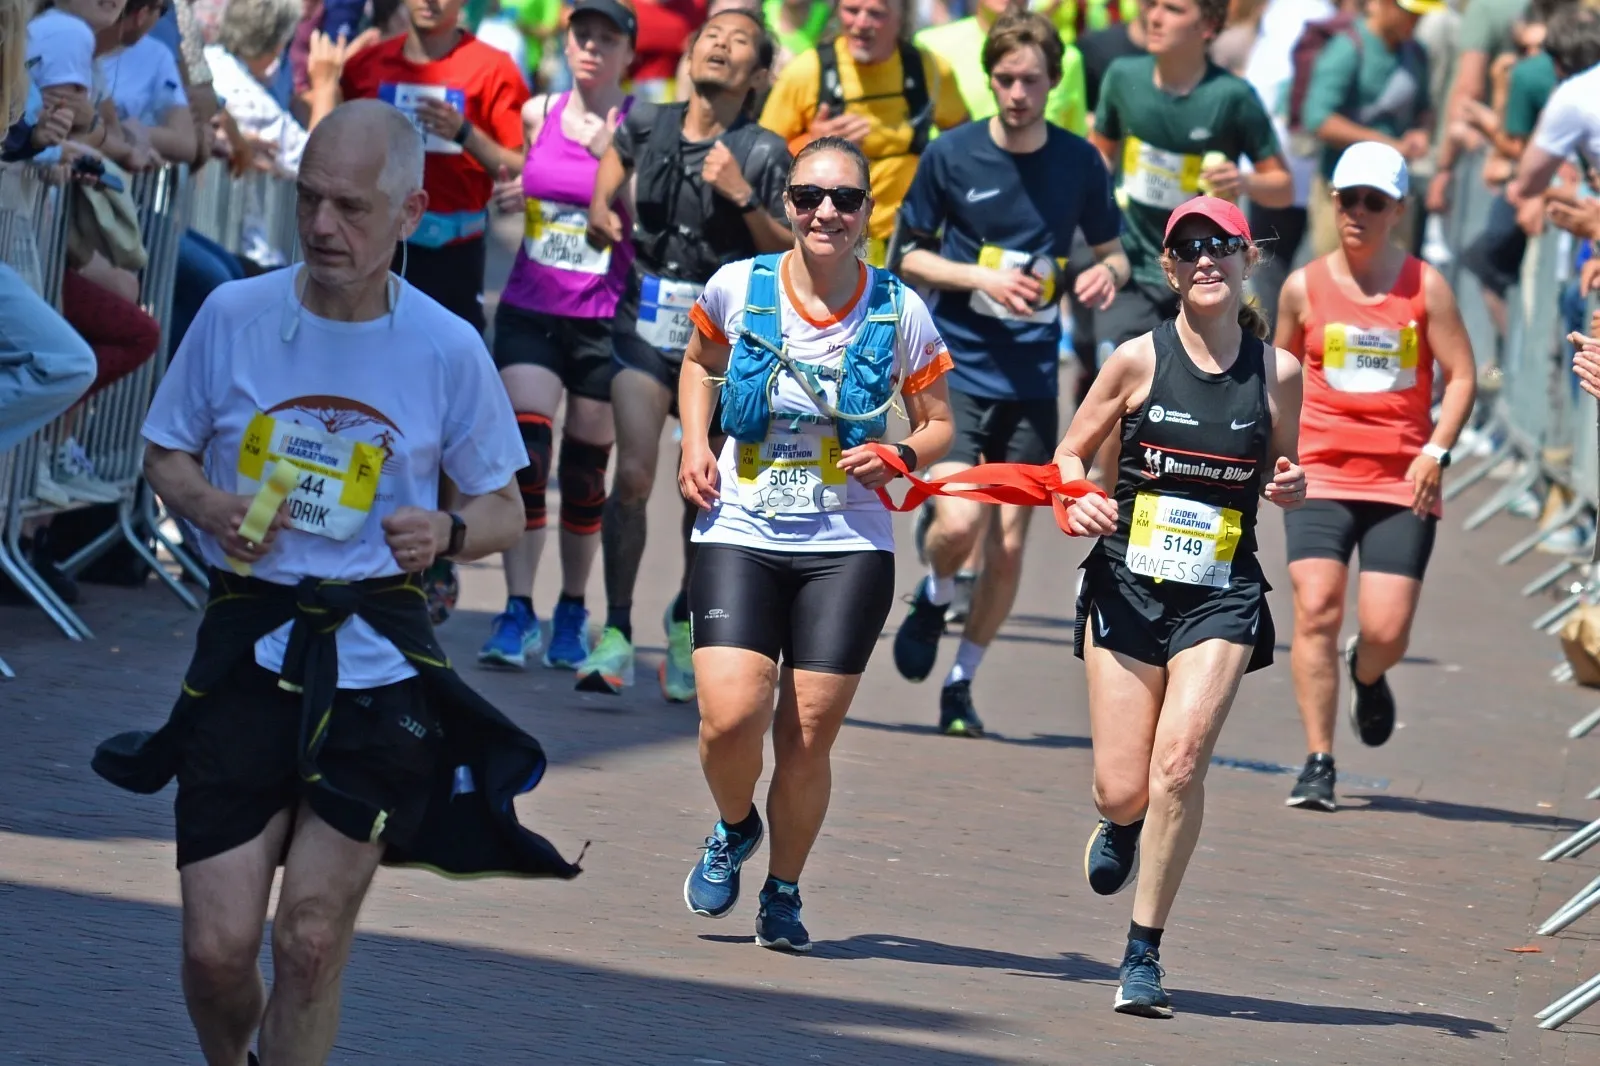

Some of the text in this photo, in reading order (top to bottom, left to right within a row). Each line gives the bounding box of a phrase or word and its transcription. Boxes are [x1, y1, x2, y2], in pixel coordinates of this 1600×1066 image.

[1356, 355, 1389, 369] 5092
[289, 436, 323, 451] LEIDEN
[773, 443, 798, 451] LEIDEN
[286, 446, 339, 467] MARATHON
[744, 447, 753, 456] 21
[771, 450, 813, 459] MARATHON
[829, 448, 839, 463] F
[742, 456, 754, 465] KM
[356, 464, 371, 483] F
[1165, 457, 1255, 482] Running Blind
[769, 469, 808, 486] 5045
[296, 473, 325, 498] 44
[752, 486, 831, 508] JESSIE
[288, 499, 331, 528] DRIK
[1139, 509, 1149, 518] 21
[1170, 508, 1198, 520] LEIDEN
[1135, 518, 1149, 528] KM
[1168, 516, 1211, 531] MARATHON
[1225, 525, 1234, 540] F
[1163, 534, 1203, 556] 5149
